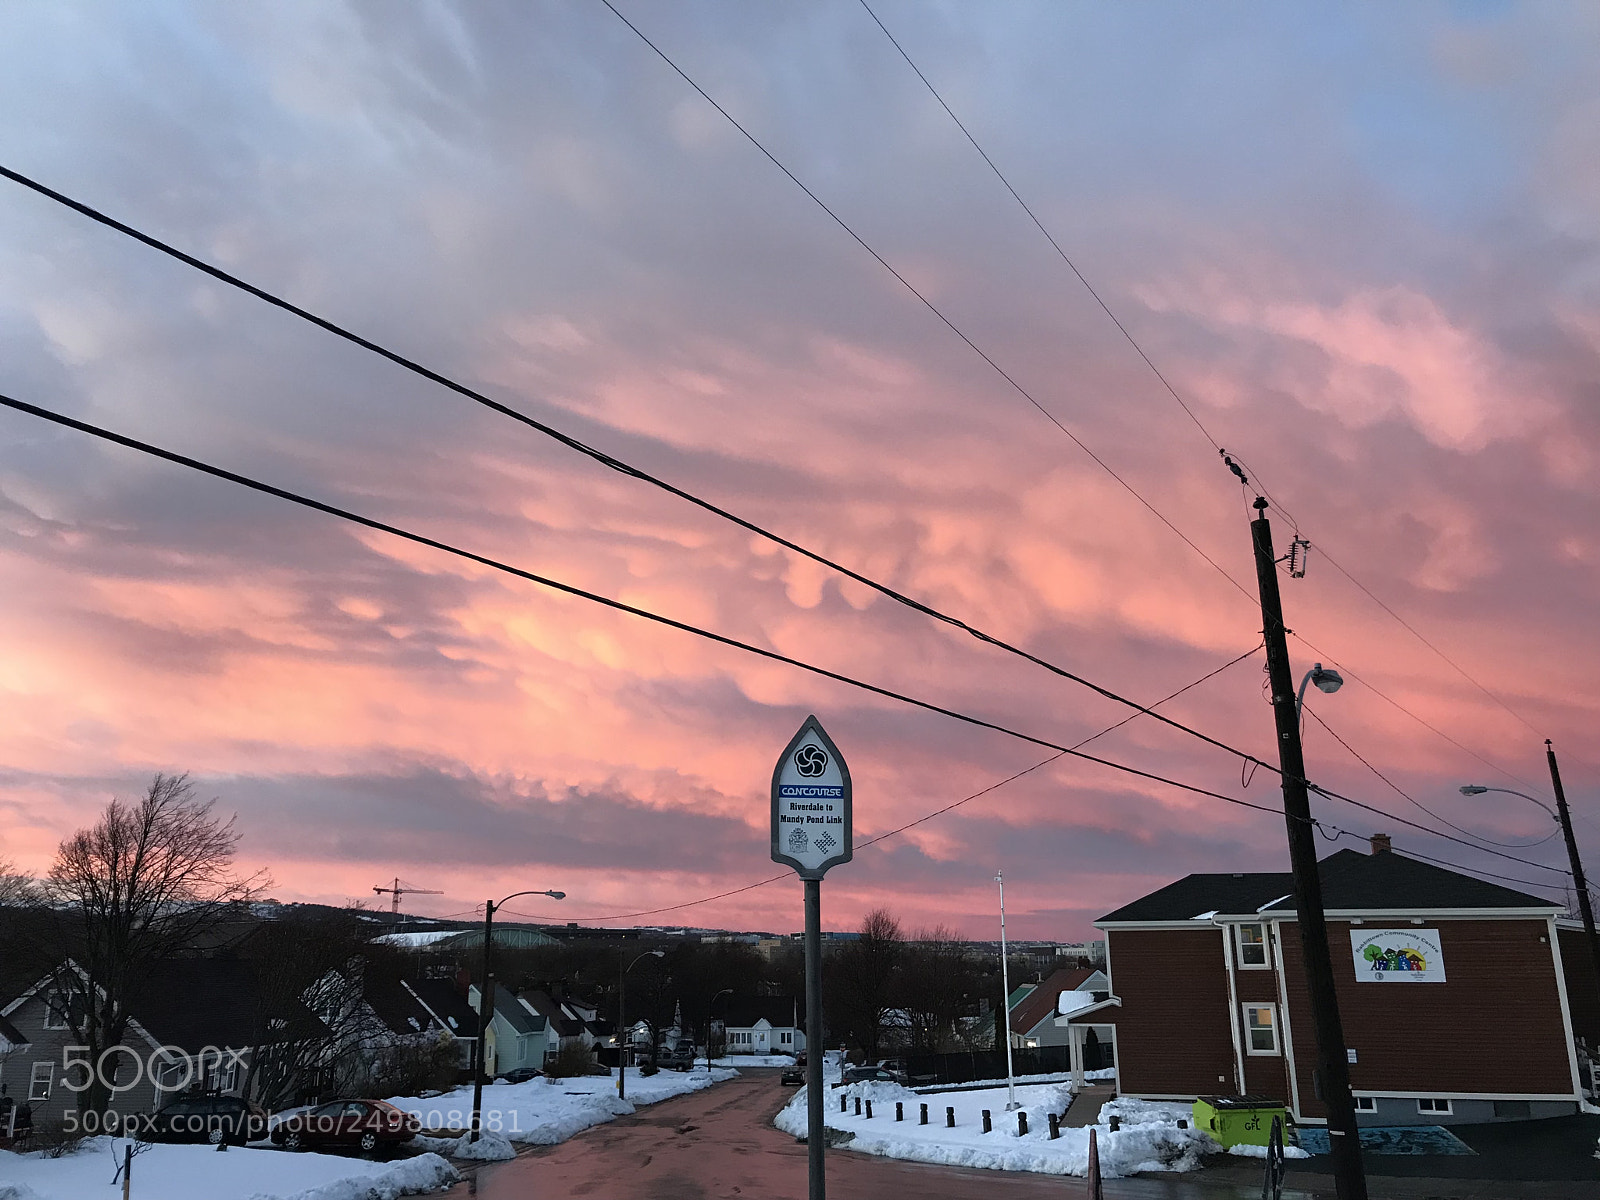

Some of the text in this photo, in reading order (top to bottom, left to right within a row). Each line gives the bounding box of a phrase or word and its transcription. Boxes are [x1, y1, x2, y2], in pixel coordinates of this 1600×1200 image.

[781, 787, 841, 796] CONCOURSE
[790, 802, 833, 811] Riverdale to
[780, 814, 842, 825] Mundy Pond Link
[1384, 931, 1420, 940] Community
[1421, 937, 1439, 954] Centre
[1244, 1117, 1261, 1131] GFL
